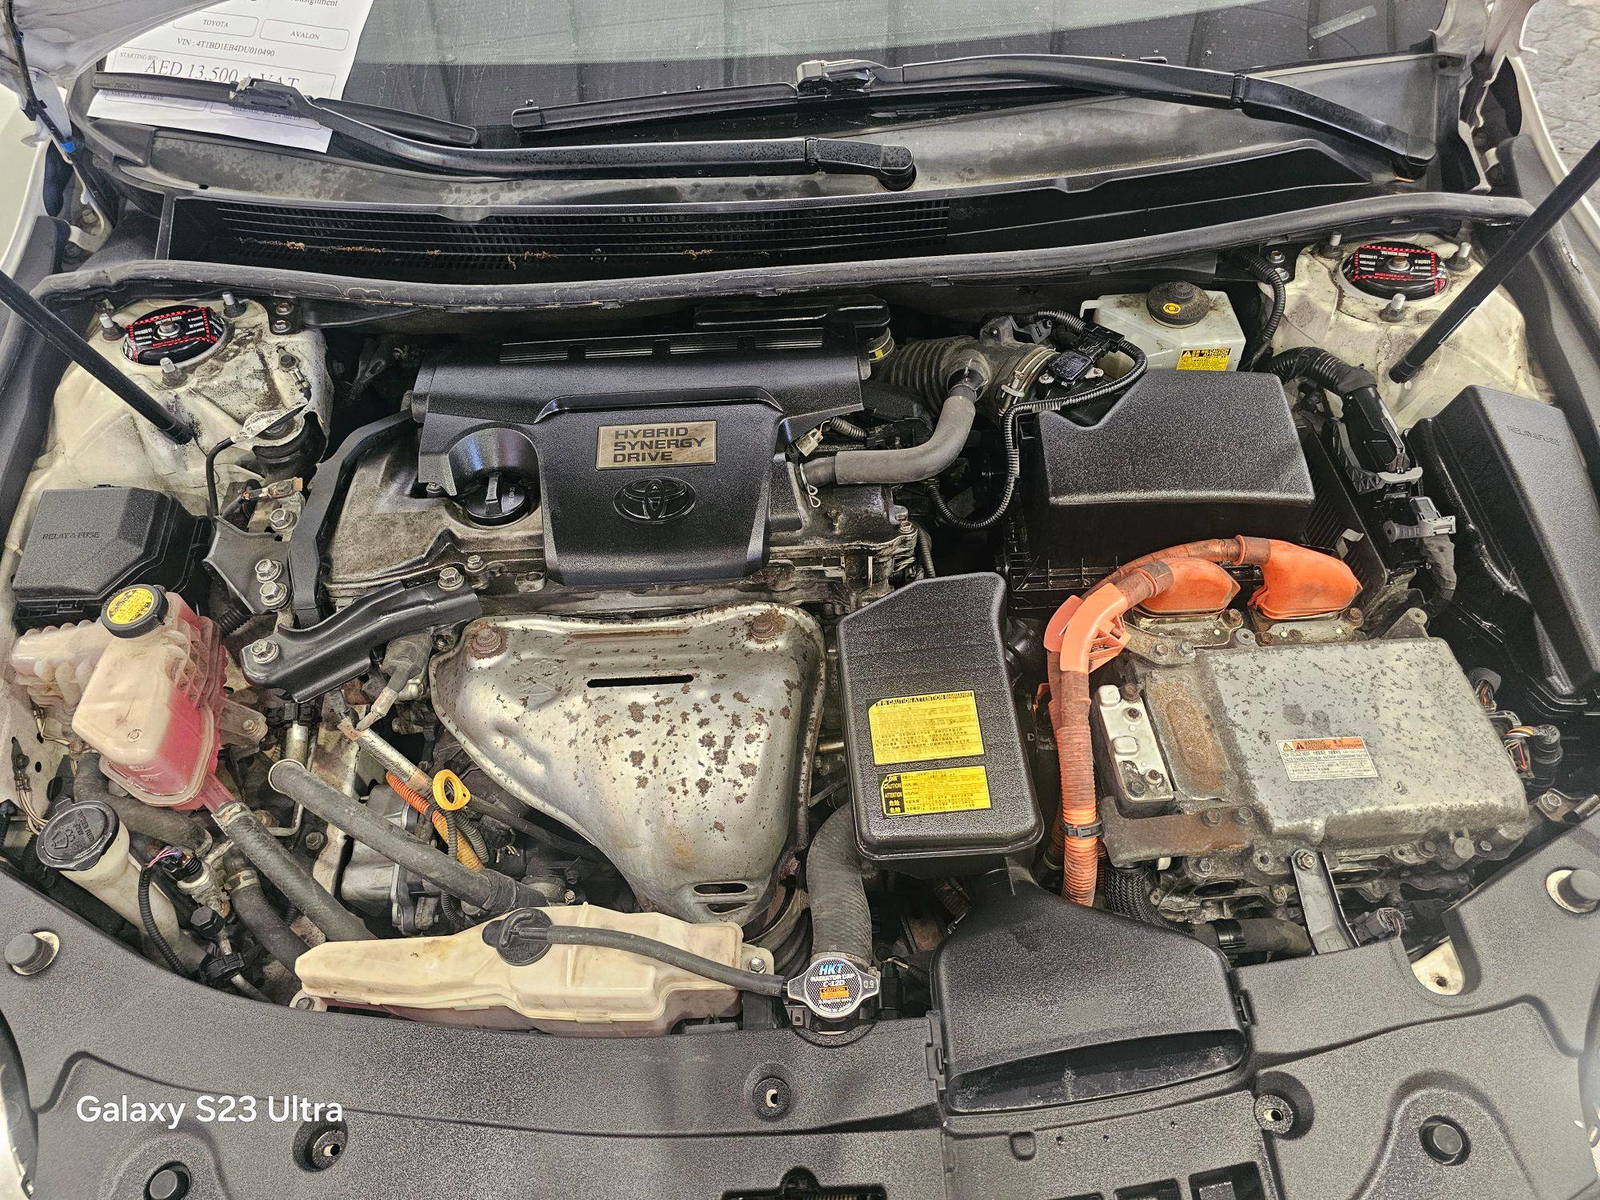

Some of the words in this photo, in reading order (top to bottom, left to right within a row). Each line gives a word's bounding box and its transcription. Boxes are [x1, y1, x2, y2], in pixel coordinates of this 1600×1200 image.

[202, 19, 230, 28] TOYOTA
[177, 37, 191, 46] VIN
[290, 31, 321, 40] AVALON
[145, 60, 183, 76] AED
[614, 427, 689, 439] HYBRID
[613, 438, 706, 451] SYNERGY
[613, 451, 673, 463] DRIVE
[819, 963, 844, 976] HKT
